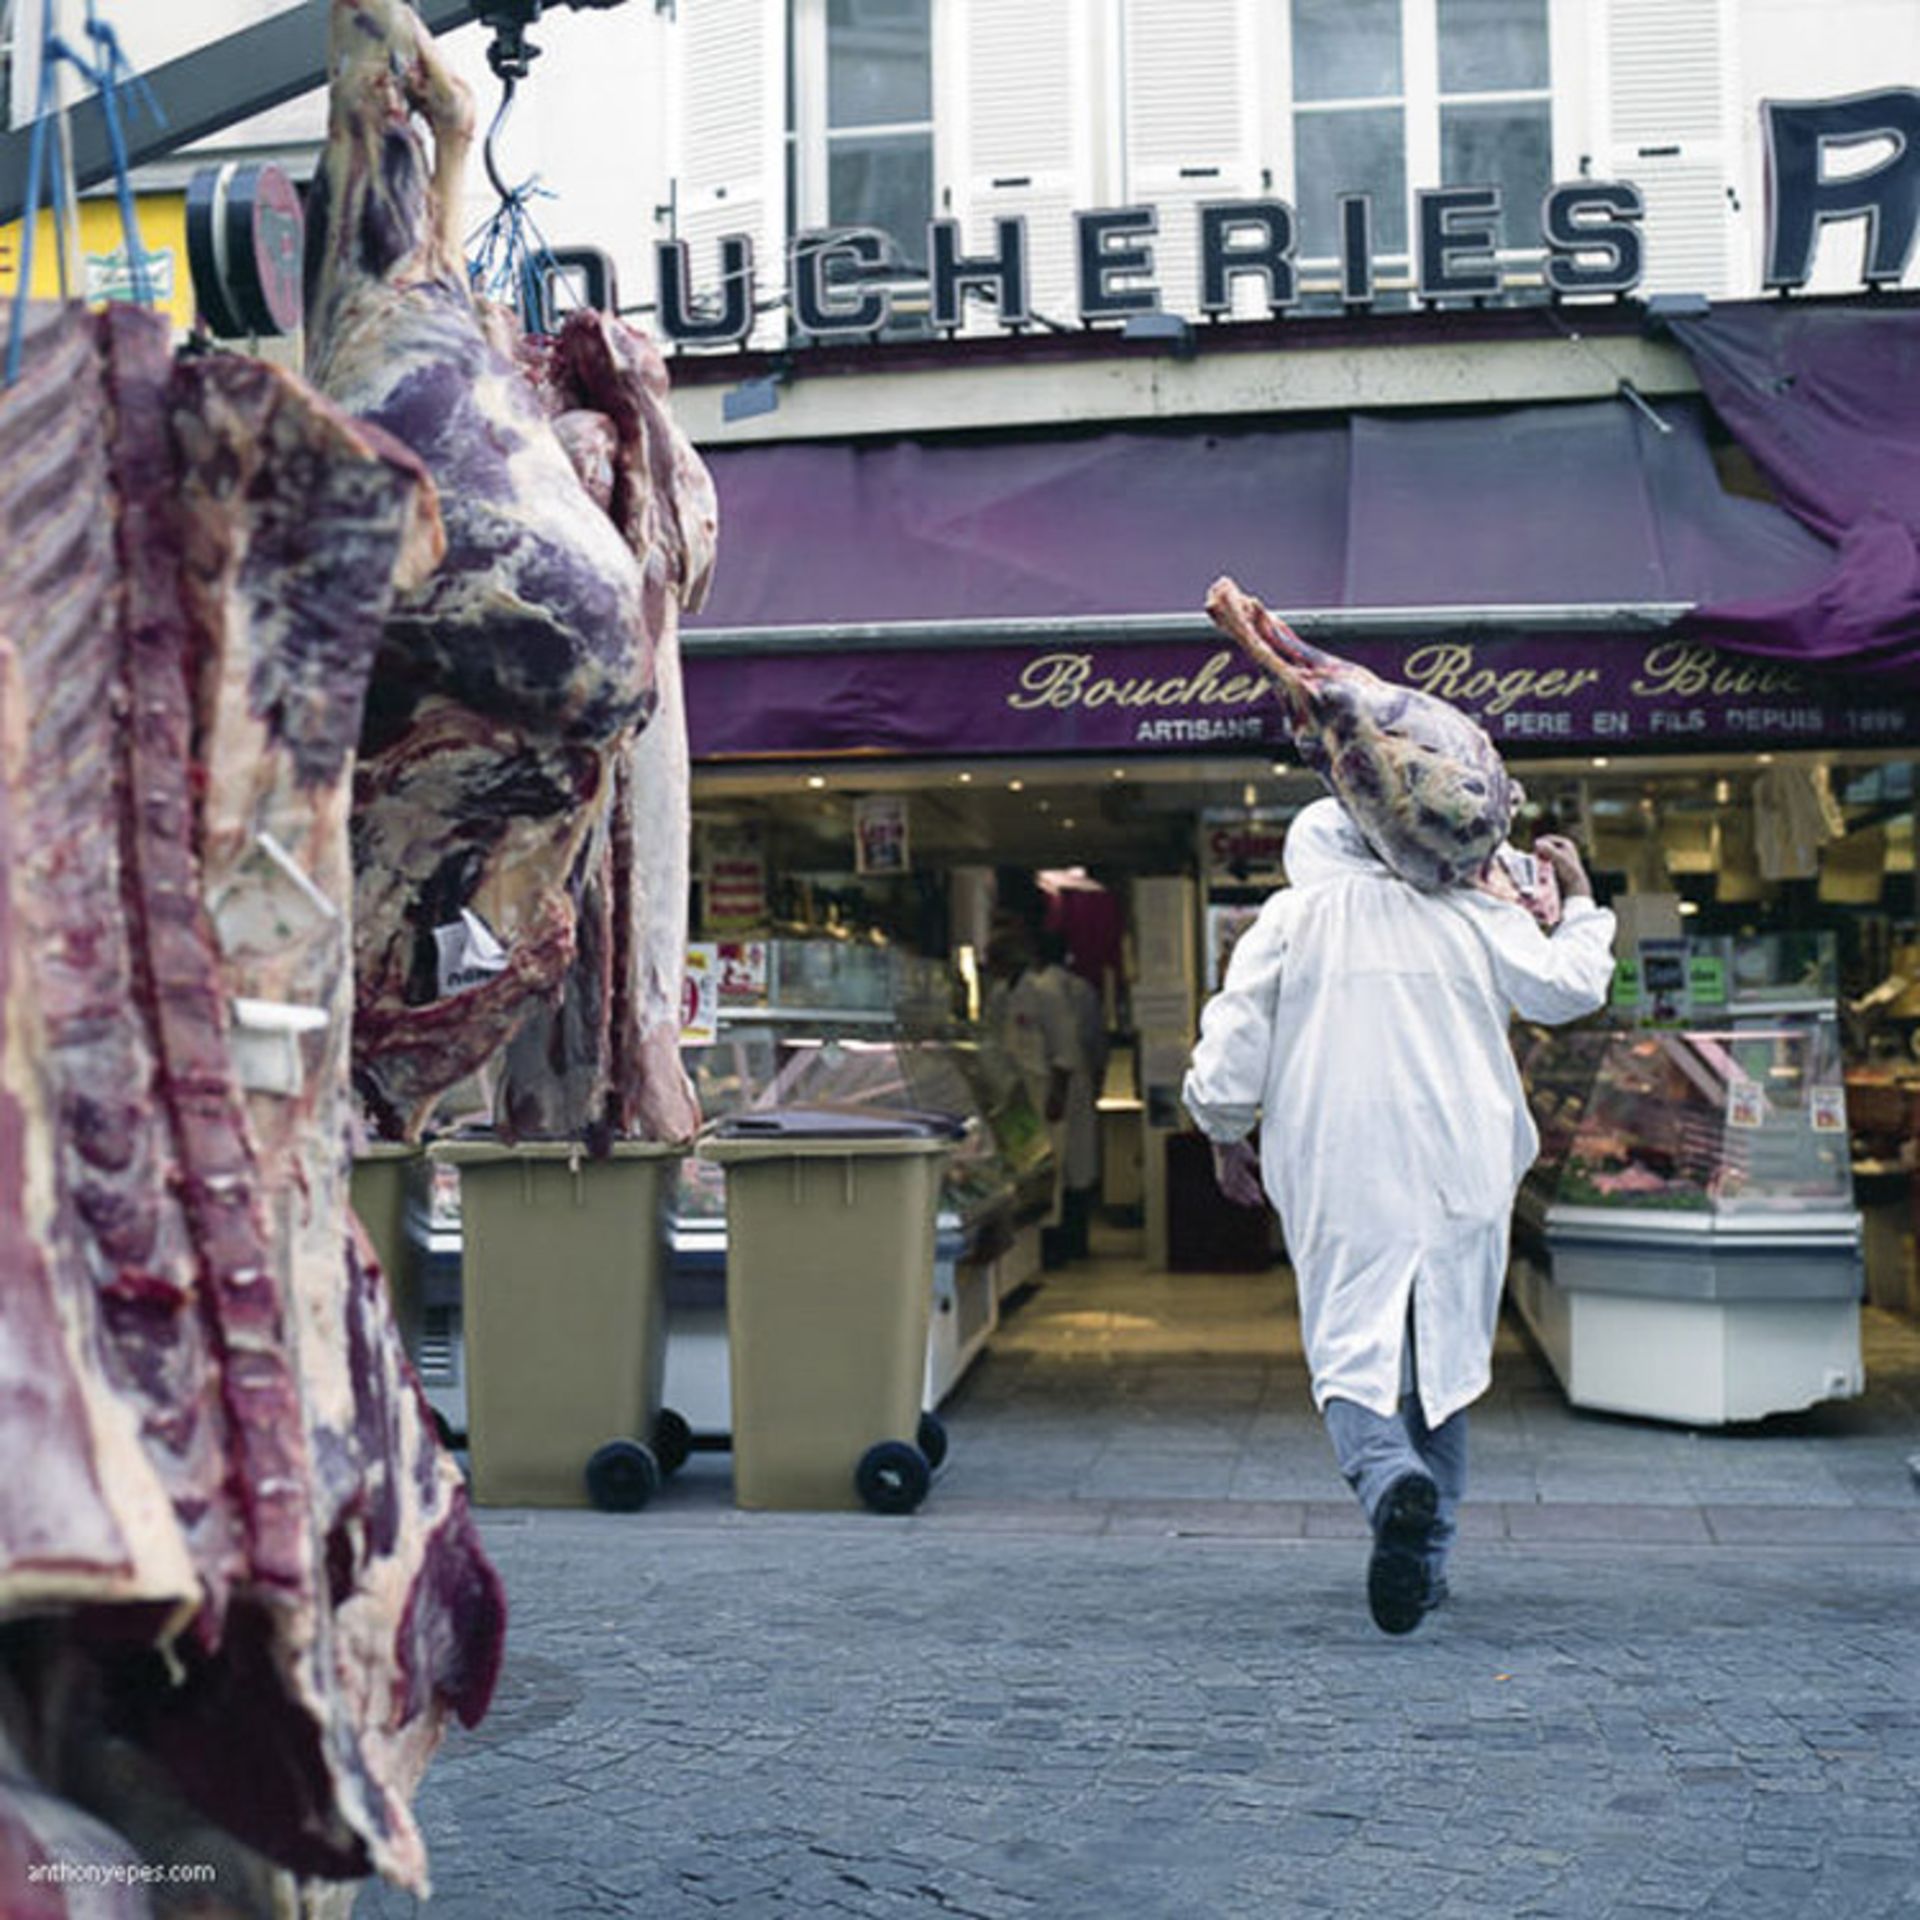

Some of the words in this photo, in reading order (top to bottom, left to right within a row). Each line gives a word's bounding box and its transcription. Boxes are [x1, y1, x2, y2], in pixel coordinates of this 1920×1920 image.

[1403, 643, 1598, 716] Roger
[1137, 718, 1262, 741] ARTISANS
[1503, 711, 1571, 734] PERE
[1592, 710, 1628, 734] EN
[1648, 708, 1707, 733] FILS
[1725, 707, 1824, 732] DEPUIS
